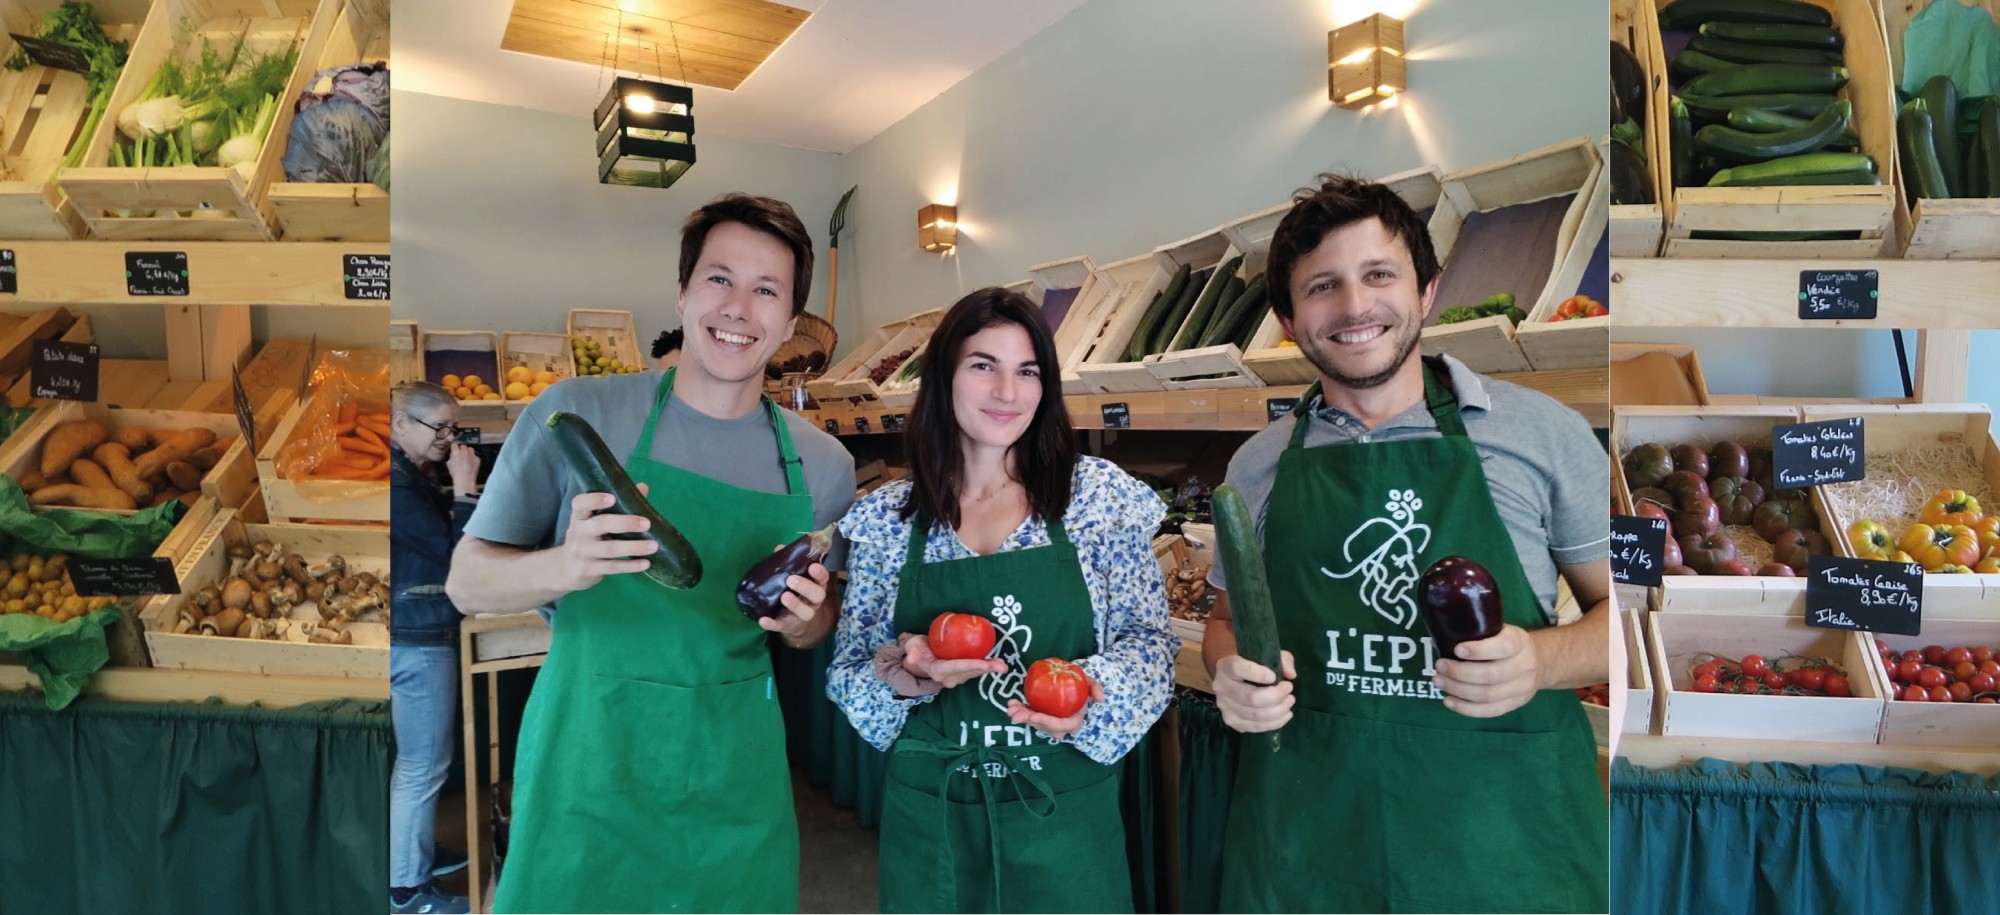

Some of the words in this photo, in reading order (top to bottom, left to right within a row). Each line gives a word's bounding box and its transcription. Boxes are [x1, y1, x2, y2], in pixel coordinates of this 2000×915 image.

[1780, 430, 1817, 444] Tomates
[1821, 566, 1870, 586] Tomates
[1903, 564, 1922, 575] 165
[1326, 627, 1437, 676] L'EPI
[1326, 672, 1345, 686] DU
[1347, 675, 1445, 699] FERMIER
